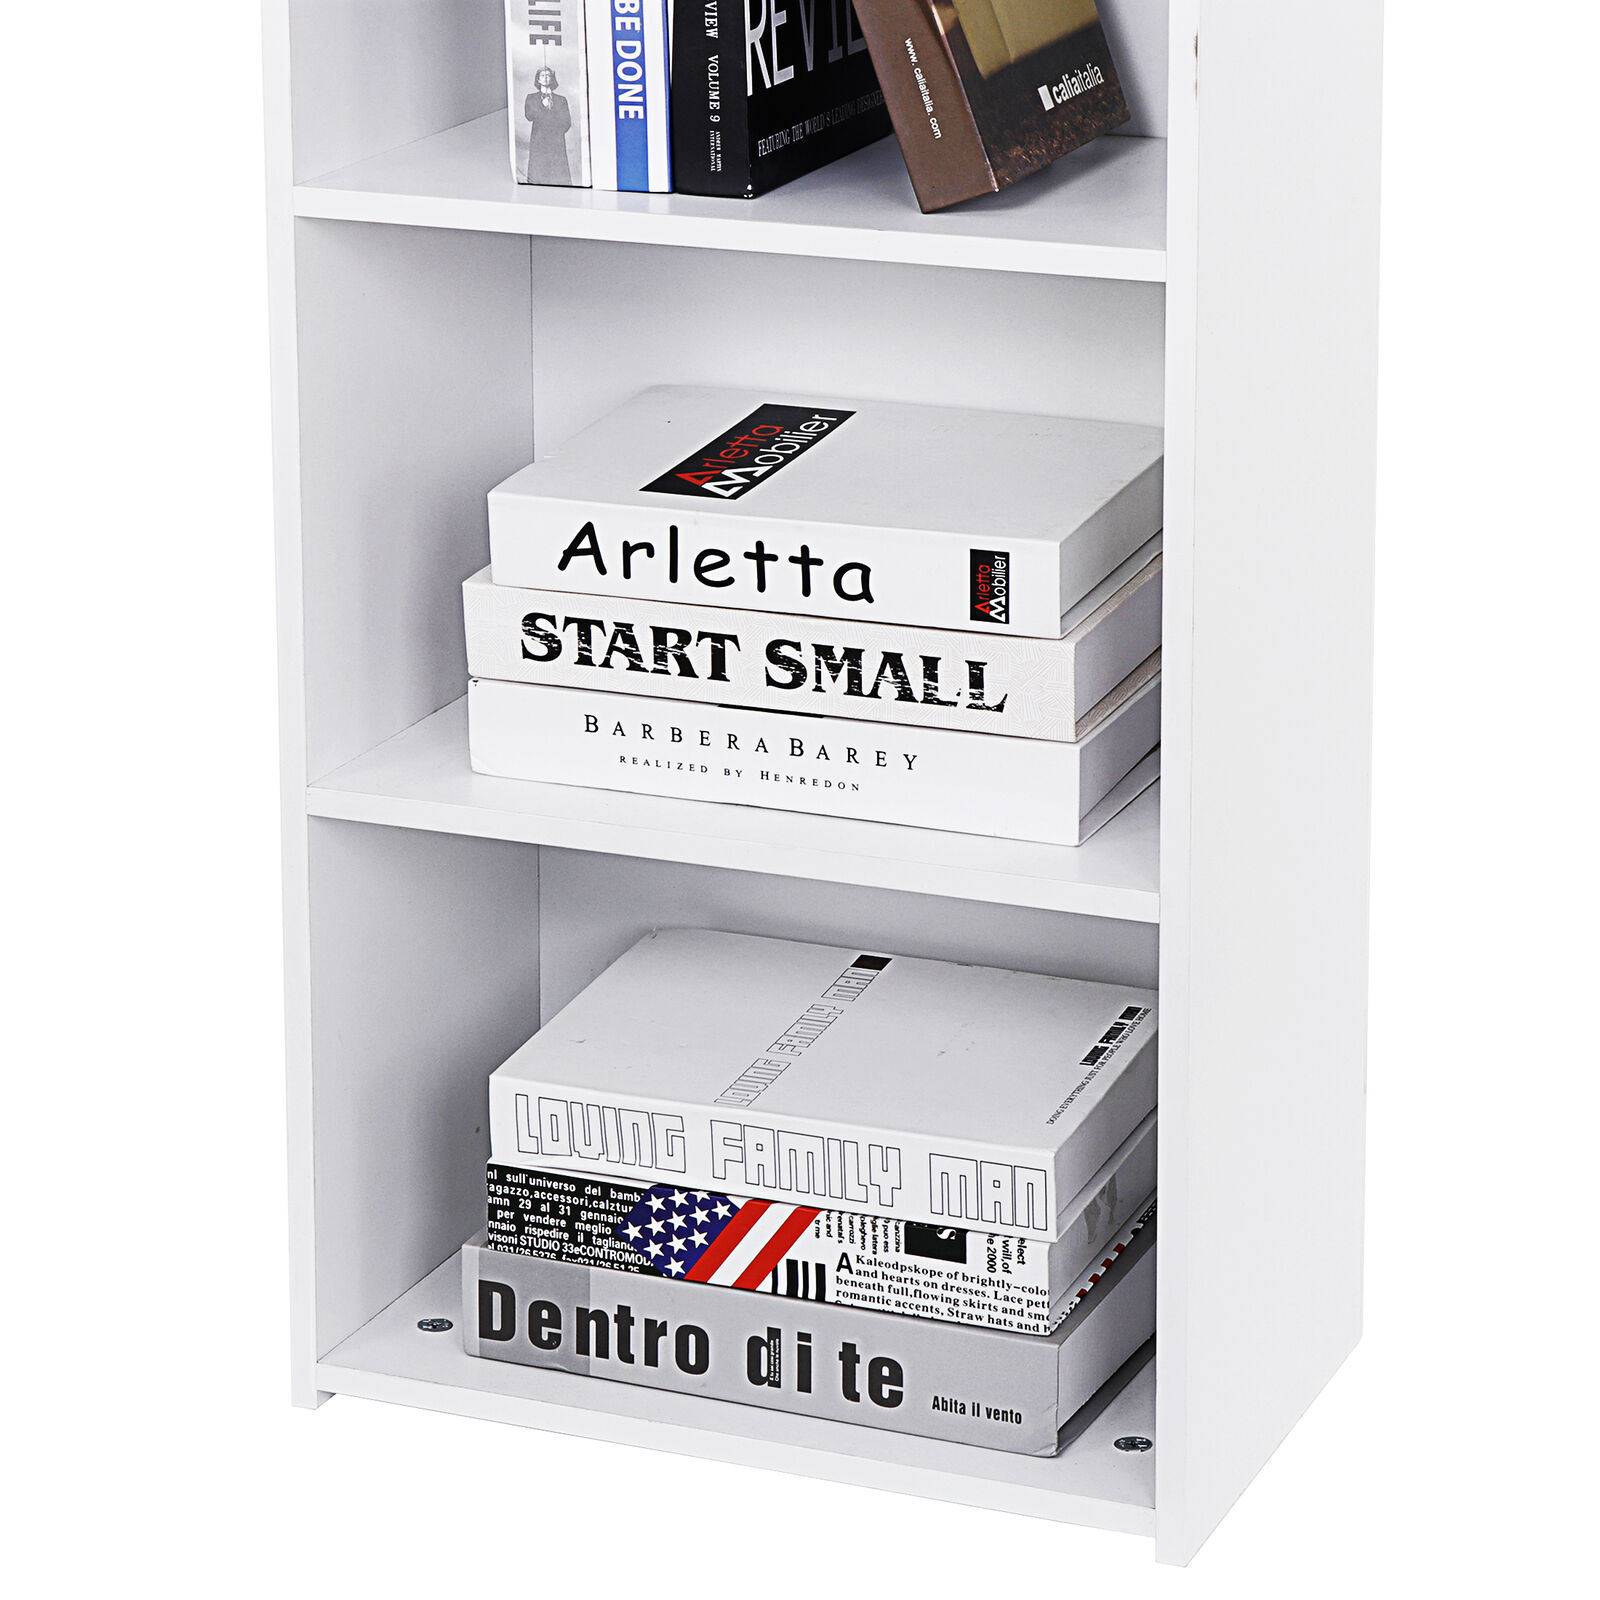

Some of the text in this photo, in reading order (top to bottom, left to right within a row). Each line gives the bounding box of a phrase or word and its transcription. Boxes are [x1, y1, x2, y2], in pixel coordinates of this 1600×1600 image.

[614, 0, 644, 120] BE DONE
[708, 54, 720, 110] VOLUME
[1052, 62, 1105, 104] caliaitalia
[709, 115, 721, 123] 9
[757, 128, 790, 157] FEATURING
[791, 122, 804, 142] THE
[804, 111, 831, 136] WORLD'S
[675, 424, 784, 486] Arletta
[701, 409, 837, 498] Mobilier
[558, 521, 875, 604] Arletta
[974, 564, 991, 614] Arletta
[989, 554, 1007, 623] Mobilier
[521, 612, 1009, 713] START SMALL
[584, 714, 918, 771] BARBERA BAREY
[619, 755, 861, 792] REALIZED BY HENREDON
[714, 967, 880, 1107] LOVING FAMILY MAN
[515, 1093, 1049, 1231] LOVING FAMILY MAN
[518, 1197, 532, 1210] 29
[540, 1201, 550, 1213] al
[558, 1205, 571, 1216] 31
[584, 1184, 601, 1196] del
[610, 1187, 645, 1203] bamb
[488, 1220, 517, 1233] nnaio
[524, 1225, 570, 1241] rispedire
[577, 1232, 584, 1243] il
[488, 1231, 518, 1245] visoni
[520, 1236, 561, 1251] STUDIO
[496, 1209, 612, 1236] per vendere meglio
[836, 1252, 854, 1275] A
[946, 1271, 960, 1281] of
[962, 1272, 1050, 1296] brightly-colo
[986, 1246, 997, 1273] 2000
[836, 1275, 885, 1293] beneath
[962, 1299, 998, 1313] skirts
[1001, 1306, 1024, 1317] and
[855, 1267, 878, 1279] and
[881, 1271, 920, 1286] hearts
[923, 1281, 938, 1290] on
[941, 1281, 990, 1299] dresses.
[994, 1290, 1023, 1304] Lace
[836, 1289, 892, 1306] romantic
[894, 1299, 944, 1317] accents,
[947, 1307, 985, 1321] Straw
[987, 1314, 1014, 1327] hats
[1016, 1321, 1040, 1333] and
[478, 1279, 710, 1374] Dentro
[838, 1342, 904, 1408] te
[932, 1395, 1023, 1424] Abita il vento
